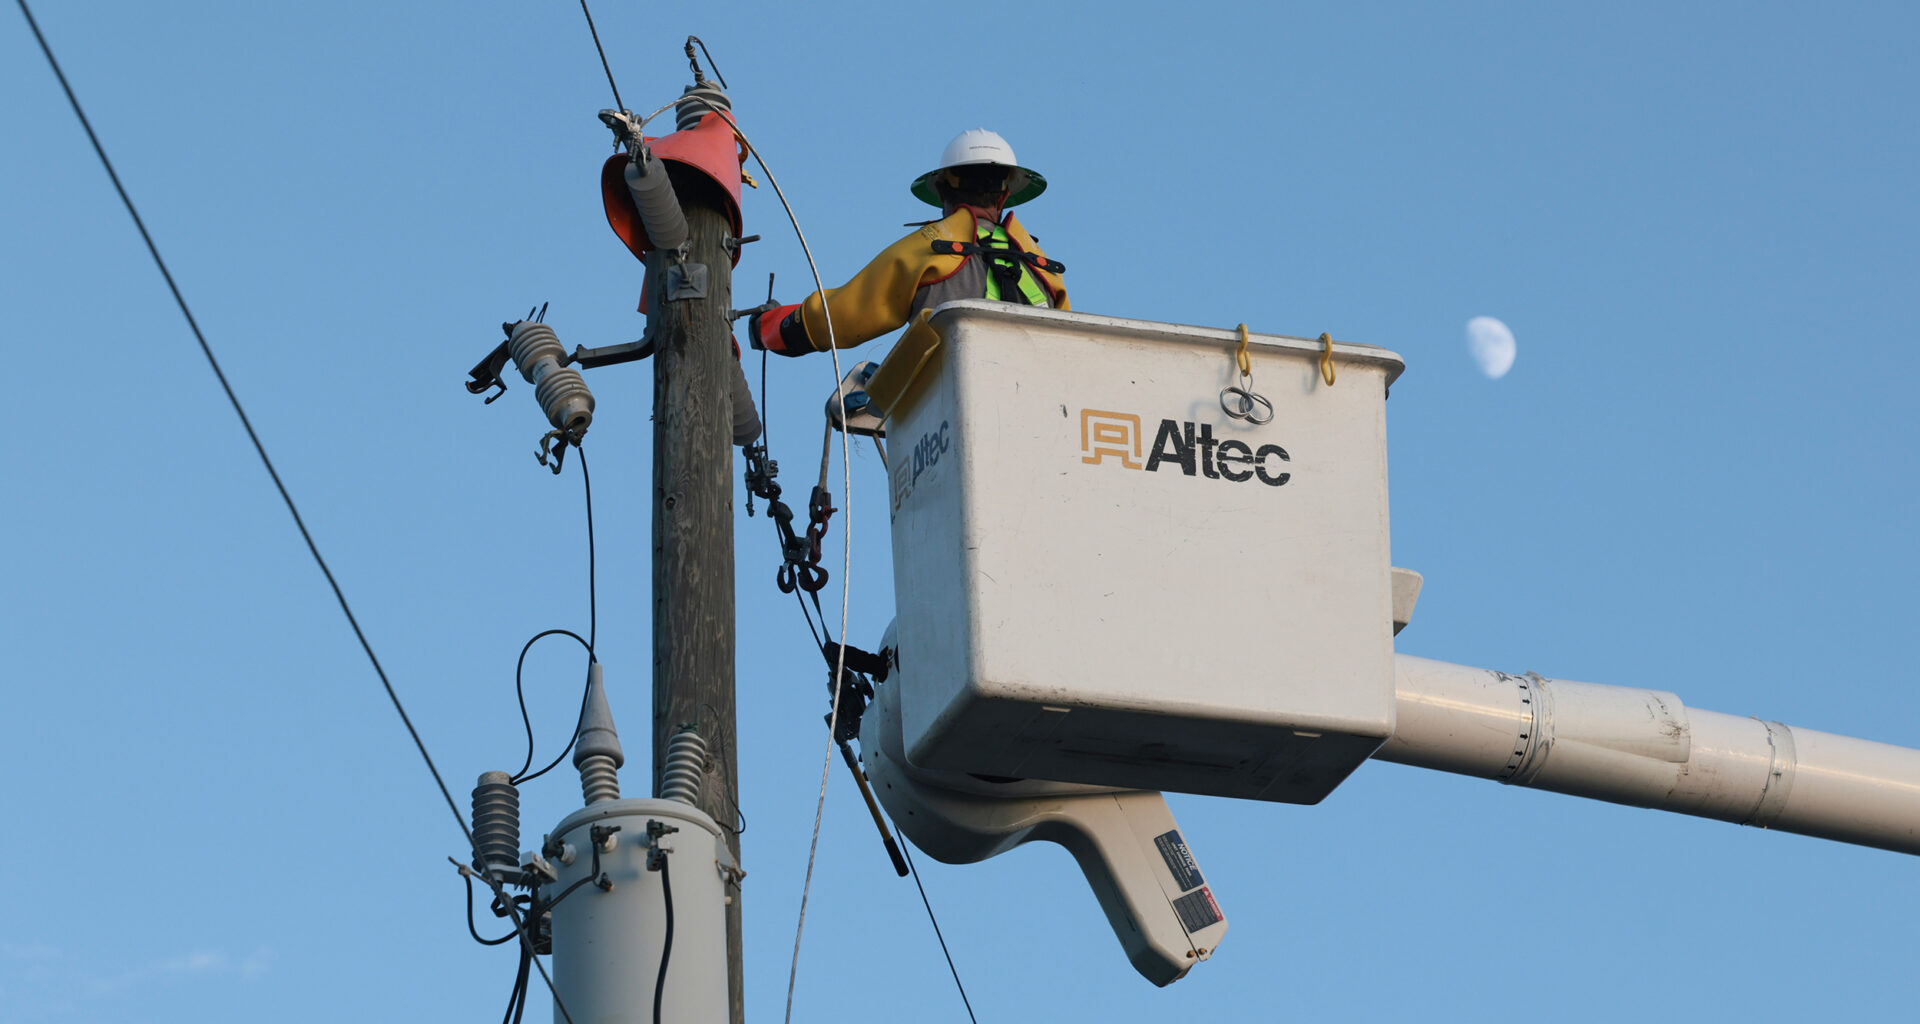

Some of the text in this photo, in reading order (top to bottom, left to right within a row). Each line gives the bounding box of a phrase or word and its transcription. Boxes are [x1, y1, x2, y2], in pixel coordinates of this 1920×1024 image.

[912, 420, 949, 487] Altec
[1145, 418, 1291, 487] Altec
[1177, 843, 1196, 870] NOTICE
